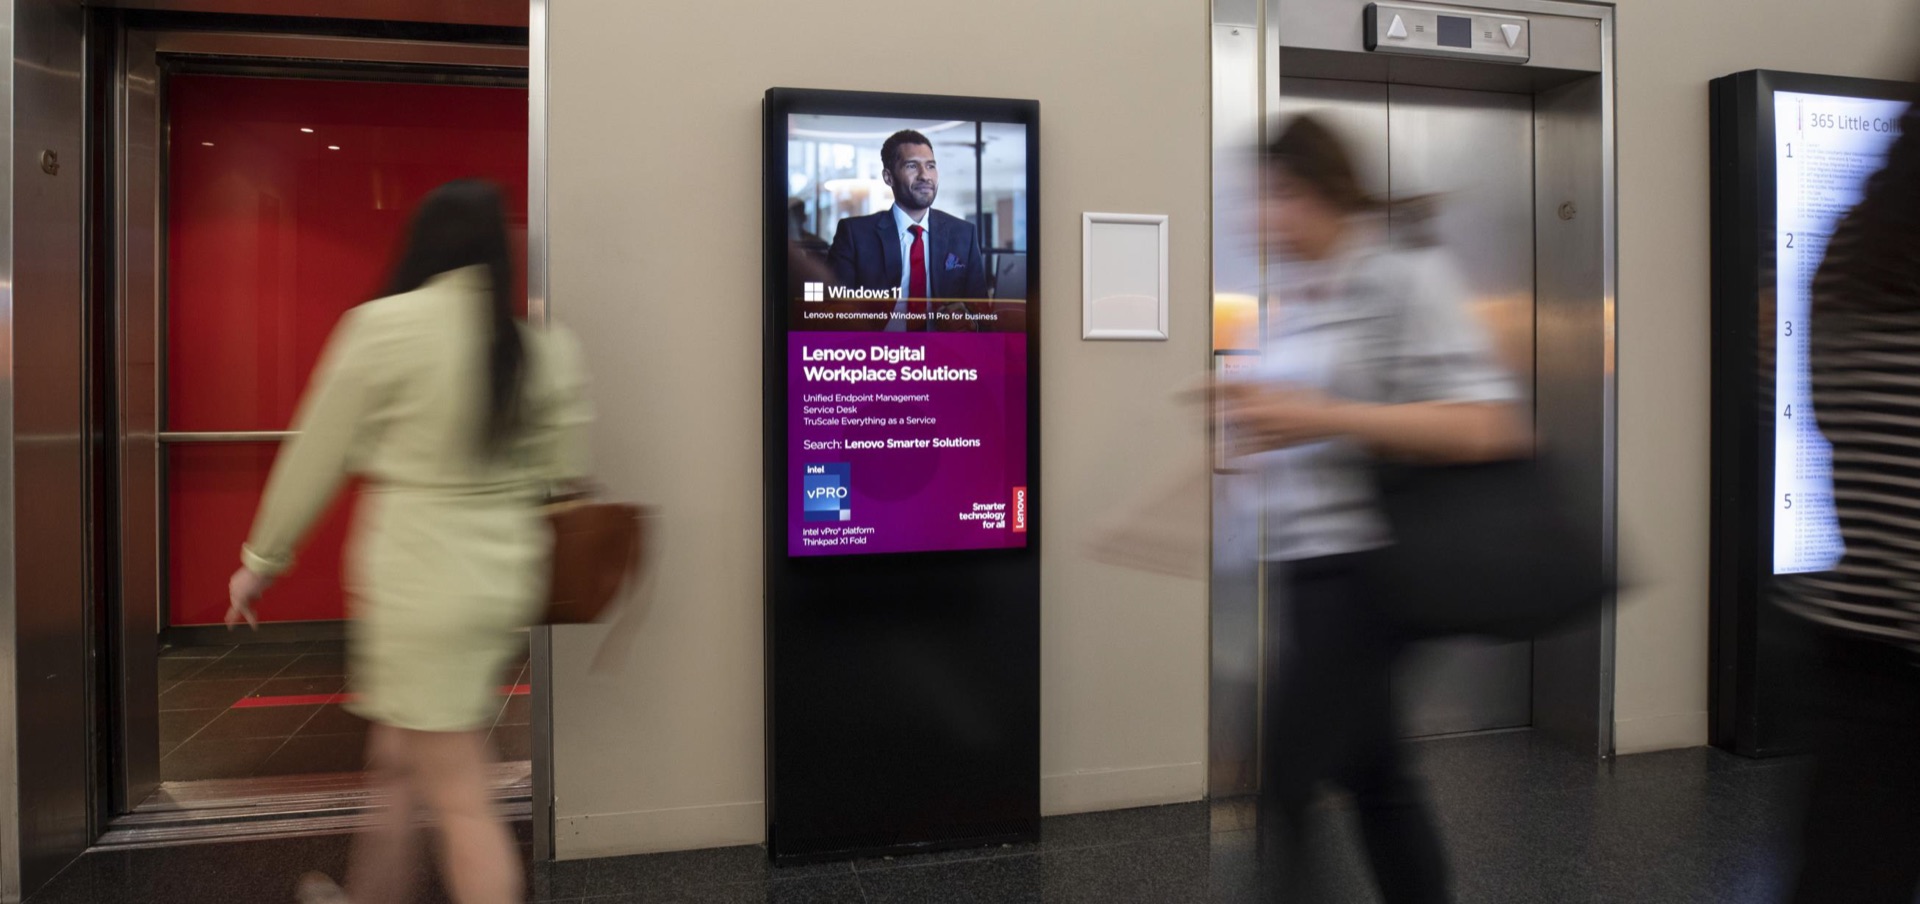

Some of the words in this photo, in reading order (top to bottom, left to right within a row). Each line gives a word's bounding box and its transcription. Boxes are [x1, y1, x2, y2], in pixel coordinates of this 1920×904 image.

[1811, 113, 1834, 128] 365
[1838, 115, 1870, 131] Little
[1786, 143, 1793, 158] 1
[41, 149, 60, 176] G
[1786, 233, 1794, 248] 2
[828, 286, 890, 300] Windows
[891, 286, 902, 300] 11
[804, 312, 834, 320] Lenovo
[836, 312, 887, 320] recommends
[890, 312, 927, 320] Windows
[928, 312, 935, 320] 11
[937, 312, 950, 320] Pro
[952, 312, 963, 320] for
[965, 312, 998, 321] business
[1784, 321, 1793, 336] 3
[803, 346, 866, 361] Lenovo
[871, 346, 925, 363] Digital
[804, 366, 896, 383] Workplace
[901, 366, 977, 381] Solutions
[804, 394, 833, 402] Unified
[836, 394, 873, 403] Endpoint
[876, 394, 929, 403] Management
[804, 406, 834, 414] Service
[1784, 404, 1792, 419] 4
[804, 417, 839, 426] TruScale
[842, 417, 886, 426] Everything
[907, 416, 936, 424] Service
[804, 440, 842, 450] Search:
[845, 439, 884, 449] Lenovo
[887, 439, 930, 448] Smarter
[933, 437, 980, 447] Solutions
[807, 465, 824, 473] intel
[807, 487, 847, 498] vPRO
[973, 503, 1005, 511] Smarter
[1784, 494, 1792, 509] 5
[1016, 490, 1024, 528] Lenovo
[959, 511, 1005, 521] technology
[982, 520, 995, 529] for
[996, 520, 1005, 529] all
[803, 528, 819, 536] Intel
[843, 527, 875, 536] platform
[803, 537, 838, 546] Thinkpad
